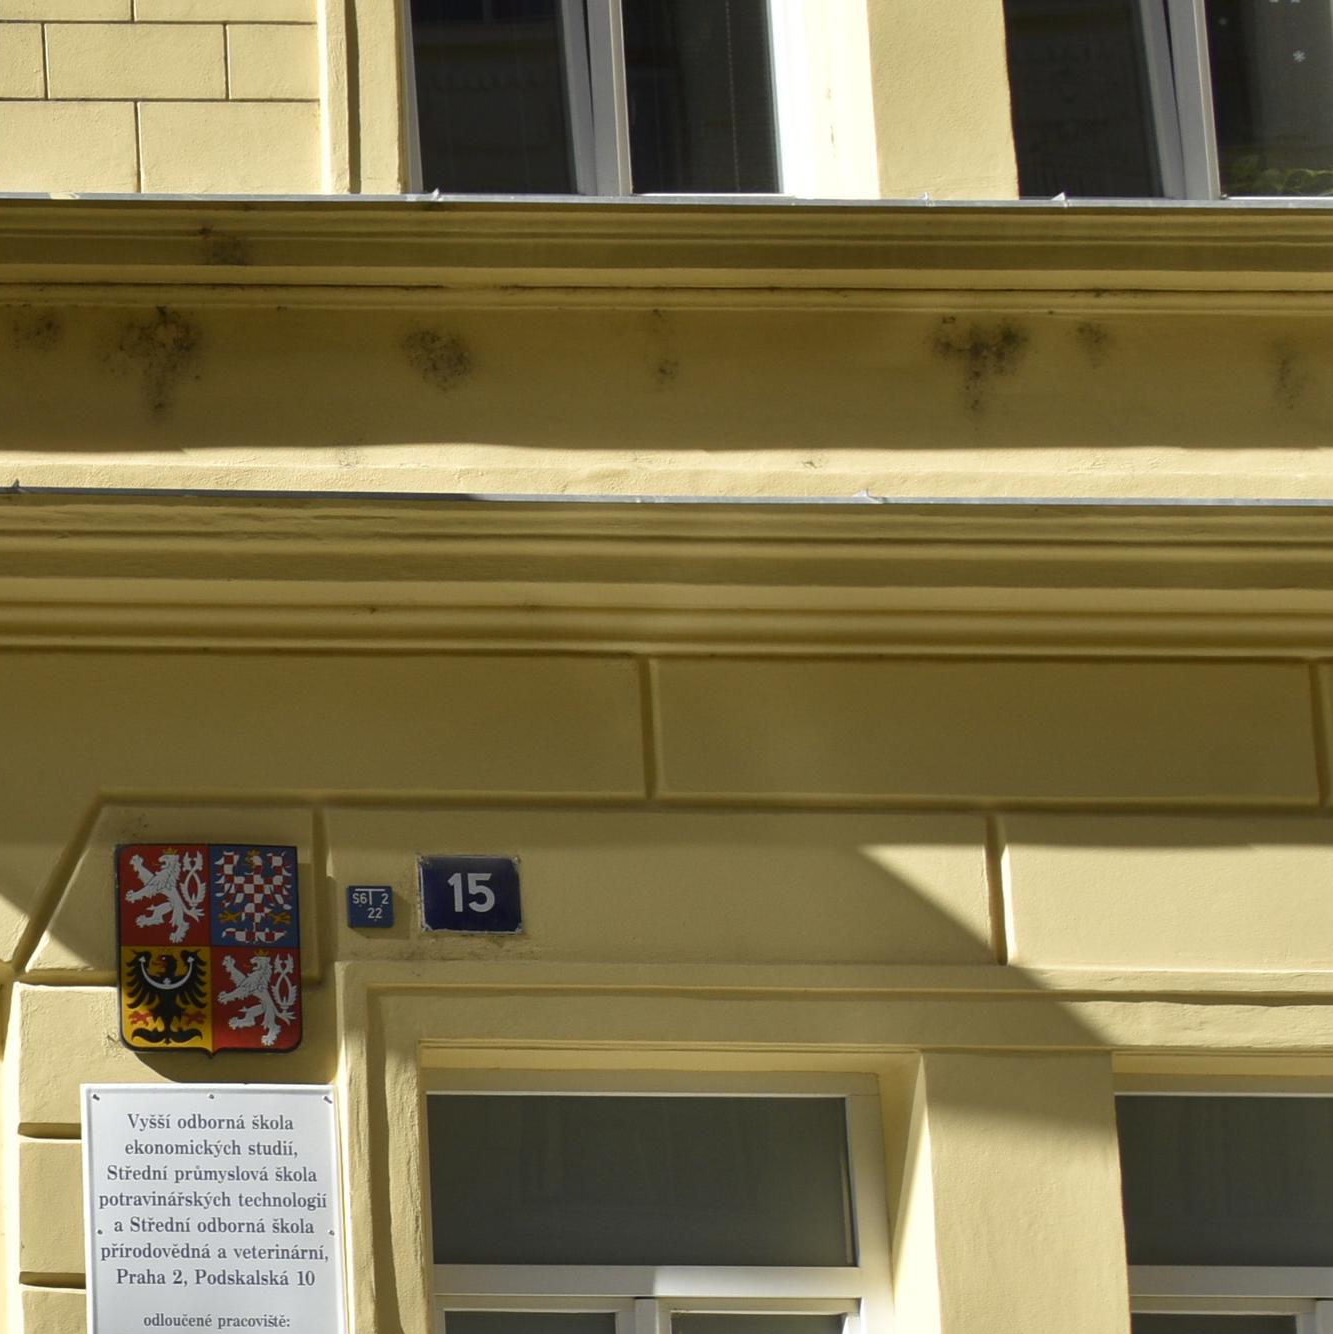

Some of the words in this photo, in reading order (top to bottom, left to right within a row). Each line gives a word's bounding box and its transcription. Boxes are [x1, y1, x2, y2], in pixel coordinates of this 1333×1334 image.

[447, 872, 495, 913] 15
[367, 907, 383, 919] 22
[127, 1113, 171, 1131] Vyšší
[177, 1114, 245, 1130] odborná
[252, 1115, 294, 1130] škola
[125, 1140, 241, 1157] ekonomických
[248, 1141, 298, 1157] studií,
[107, 1165, 168, 1181] Střední
[174, 1165, 269, 1183] průmyslová
[275, 1166, 318, 1182] škola
[99, 1191, 231, 1210] potravinářských
[238, 1192, 327, 1211] technologií
[114, 1221, 123, 1232] a
[130, 1216, 191, 1233] Střední
[197, 1217, 265, 1233] odborná
[272, 1218, 314, 1234] škola
[101, 1243, 210, 1261] přírodovědná
[217, 1248, 227, 1259] a
[233, 1245, 329, 1262] veterinární,
[116, 1268, 166, 1285] Praha
[172, 1269, 188, 1286] 2,
[194, 1269, 289, 1286] Podskalská
[297, 1271, 315, 1286] 10
[144, 1313, 213, 1328] odloučené
[217, 1314, 291, 1329] pracoviště:
